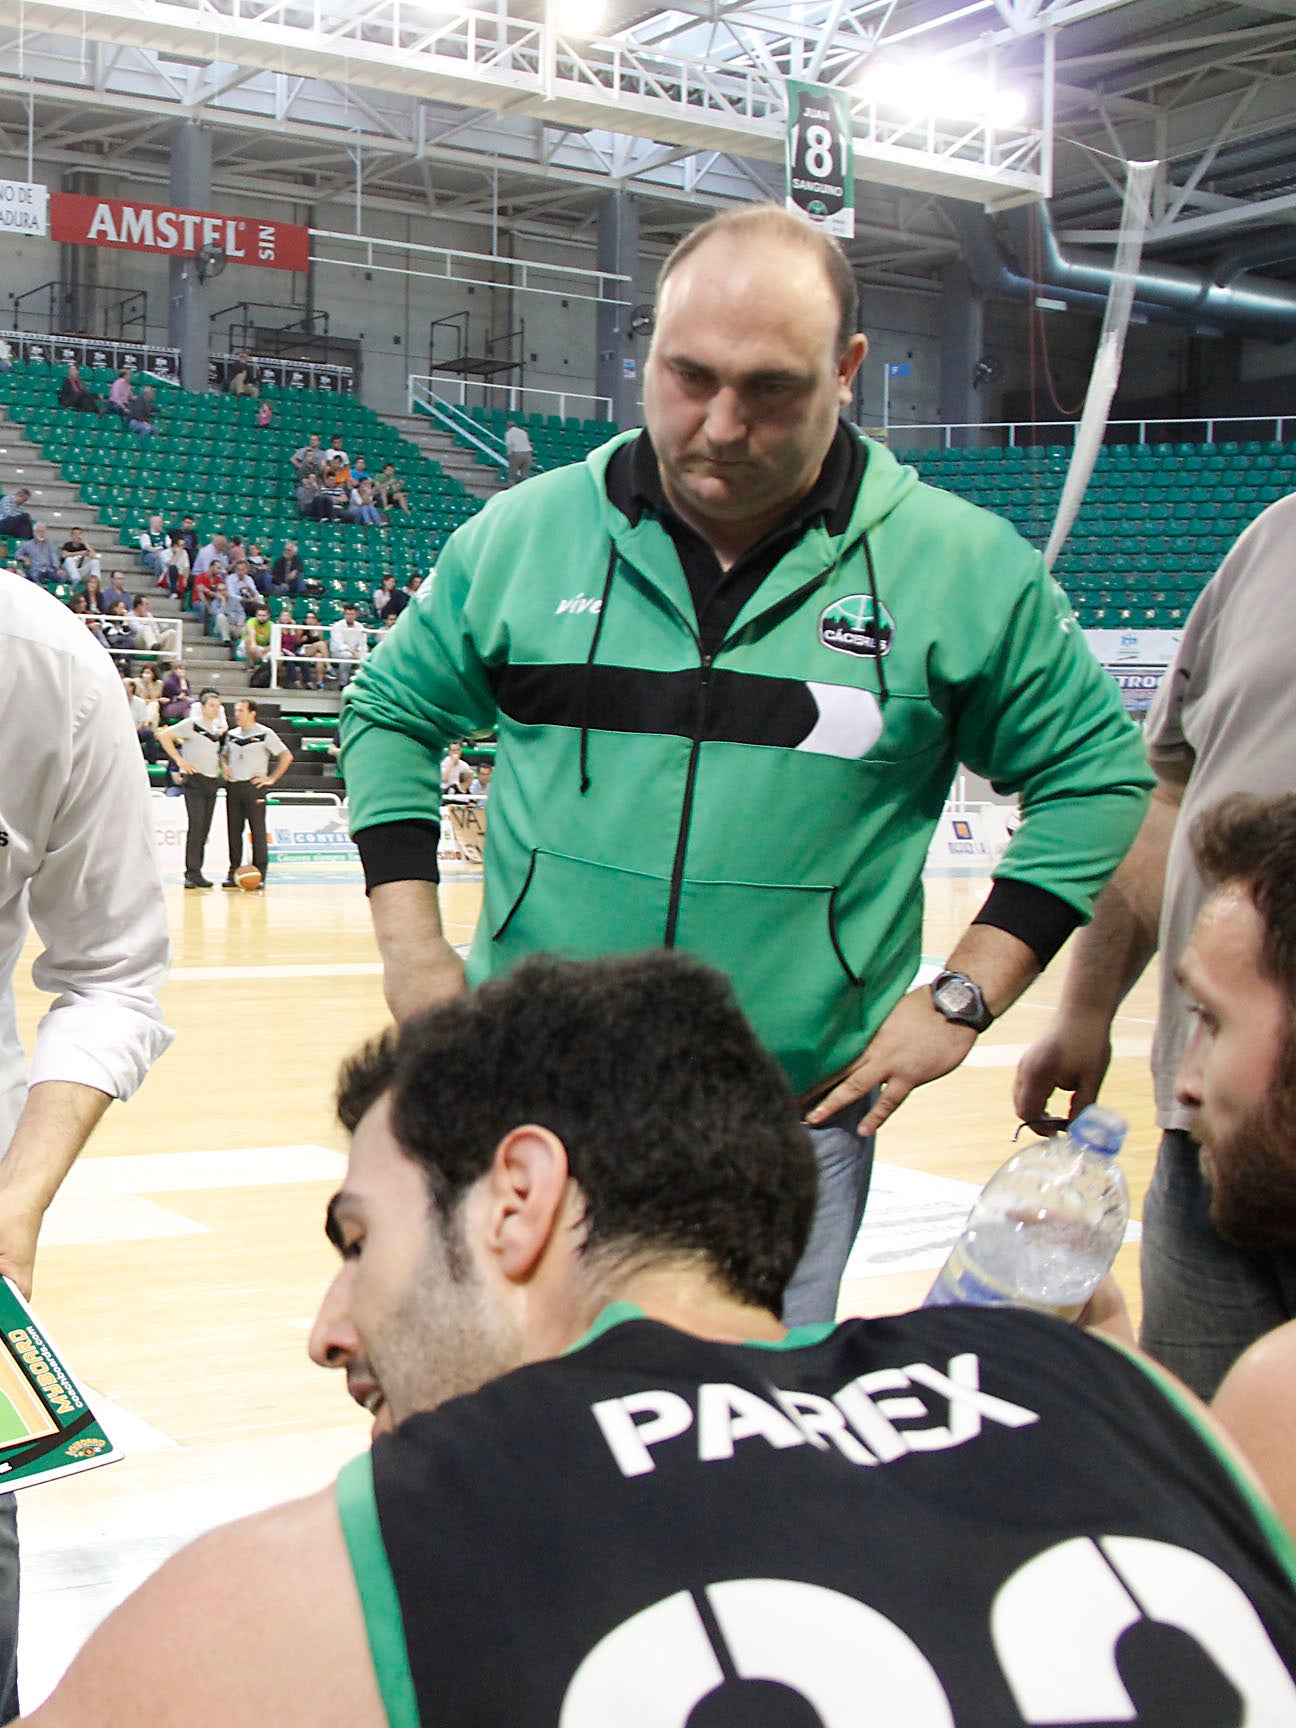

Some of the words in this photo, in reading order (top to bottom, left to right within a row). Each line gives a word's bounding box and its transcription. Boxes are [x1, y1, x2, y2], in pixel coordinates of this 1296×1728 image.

[805, 125, 833, 177] 8
[18, 188, 33, 204] DE
[258, 225, 276, 261] SIN
[8, 1328, 75, 1415] MYBOARD
[26, 1325, 83, 1409] coachboards.com
[591, 1352, 1040, 1478] PAREX
